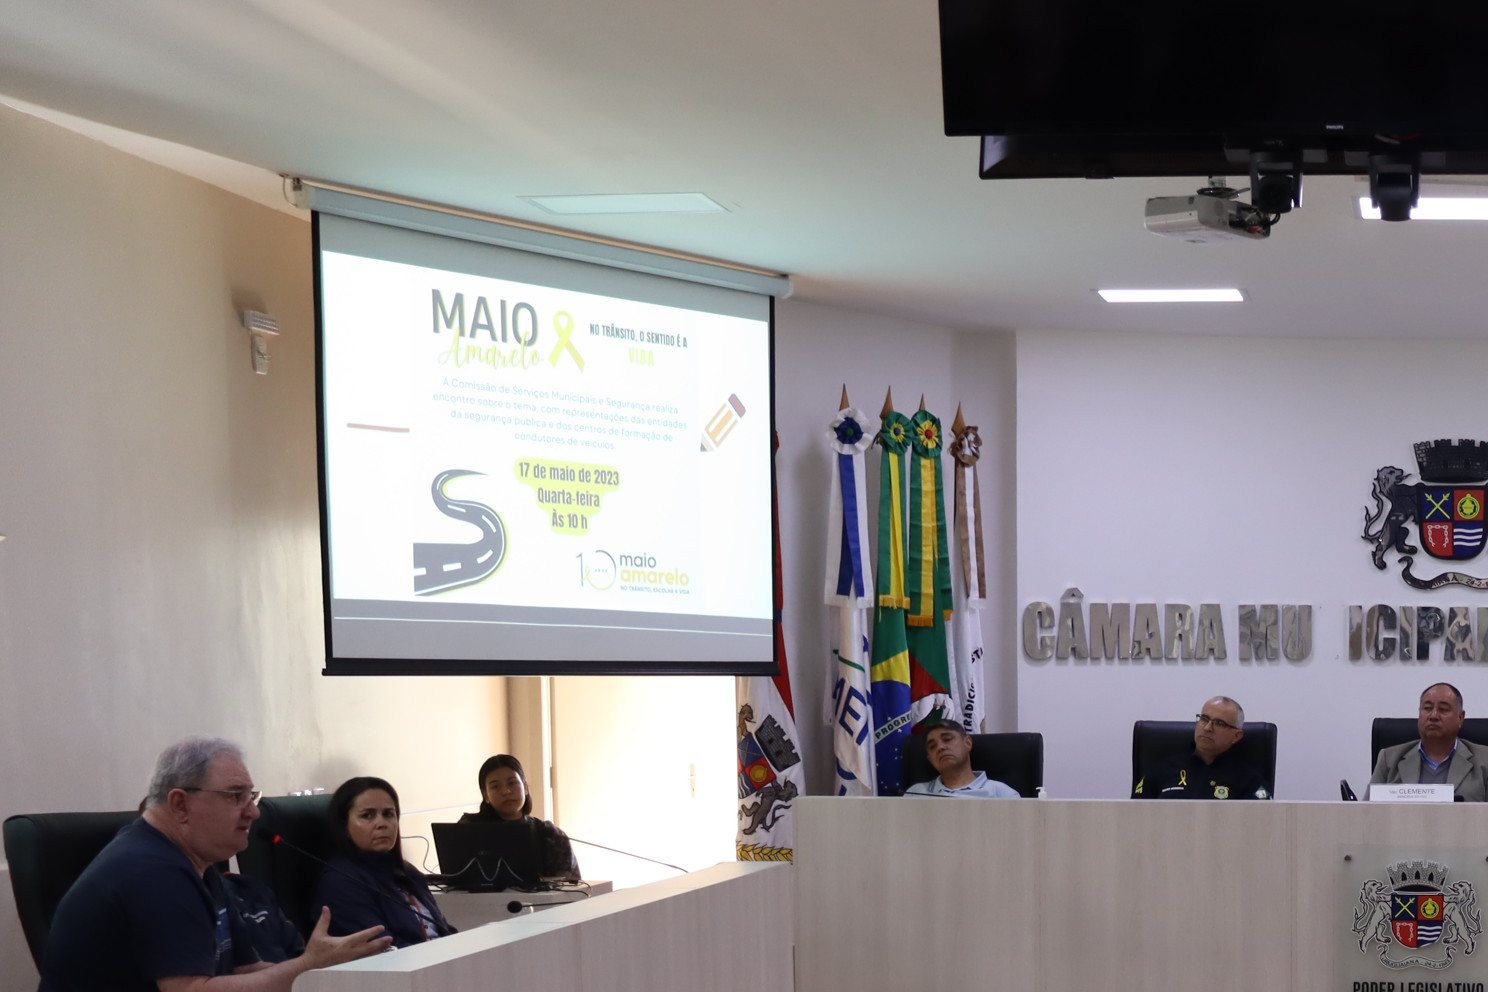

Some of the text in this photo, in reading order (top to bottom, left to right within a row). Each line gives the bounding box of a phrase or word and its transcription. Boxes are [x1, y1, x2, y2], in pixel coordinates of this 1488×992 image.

[431, 288, 540, 347] MAIO
[589, 322, 688, 348] NO TRÂNSITO, O SENTIDO É A
[437, 327, 545, 370] Amarelo
[628, 347, 656, 366] VIDA
[451, 378, 496, 393] Comissão
[498, 384, 510, 394] de
[512, 386, 550, 400] Serviços
[551, 390, 596, 405] Municipais
[598, 398, 604, 406] e
[606, 398, 650, 414] Segurança
[652, 404, 678, 416] realiza
[432, 392, 476, 406] encontro
[477, 396, 503, 409] sobre
[506, 401, 512, 410] o
[540, 404, 560, 415] com
[562, 406, 629, 424] representações
[630, 414, 646, 426] das
[648, 416, 688, 431] entidades
[450, 408, 462, 420] da
[464, 411, 512, 426] segurança
[556, 420, 572, 432] dos
[574, 424, 606, 436] centros
[608, 425, 620, 436] de
[620, 428, 661, 443] formação
[662, 431, 673, 442] de
[514, 430, 565, 445] condutores
[567, 436, 578, 446] de
[519, 462, 620, 486] 17 de maio de 2023
[537, 487, 600, 508] Quarta-feira
[552, 508, 588, 530] Às 10 h
[620, 553, 656, 568] maio
[620, 568, 690, 586] amarelo
[1022, 587, 1228, 660] CÂMARA
